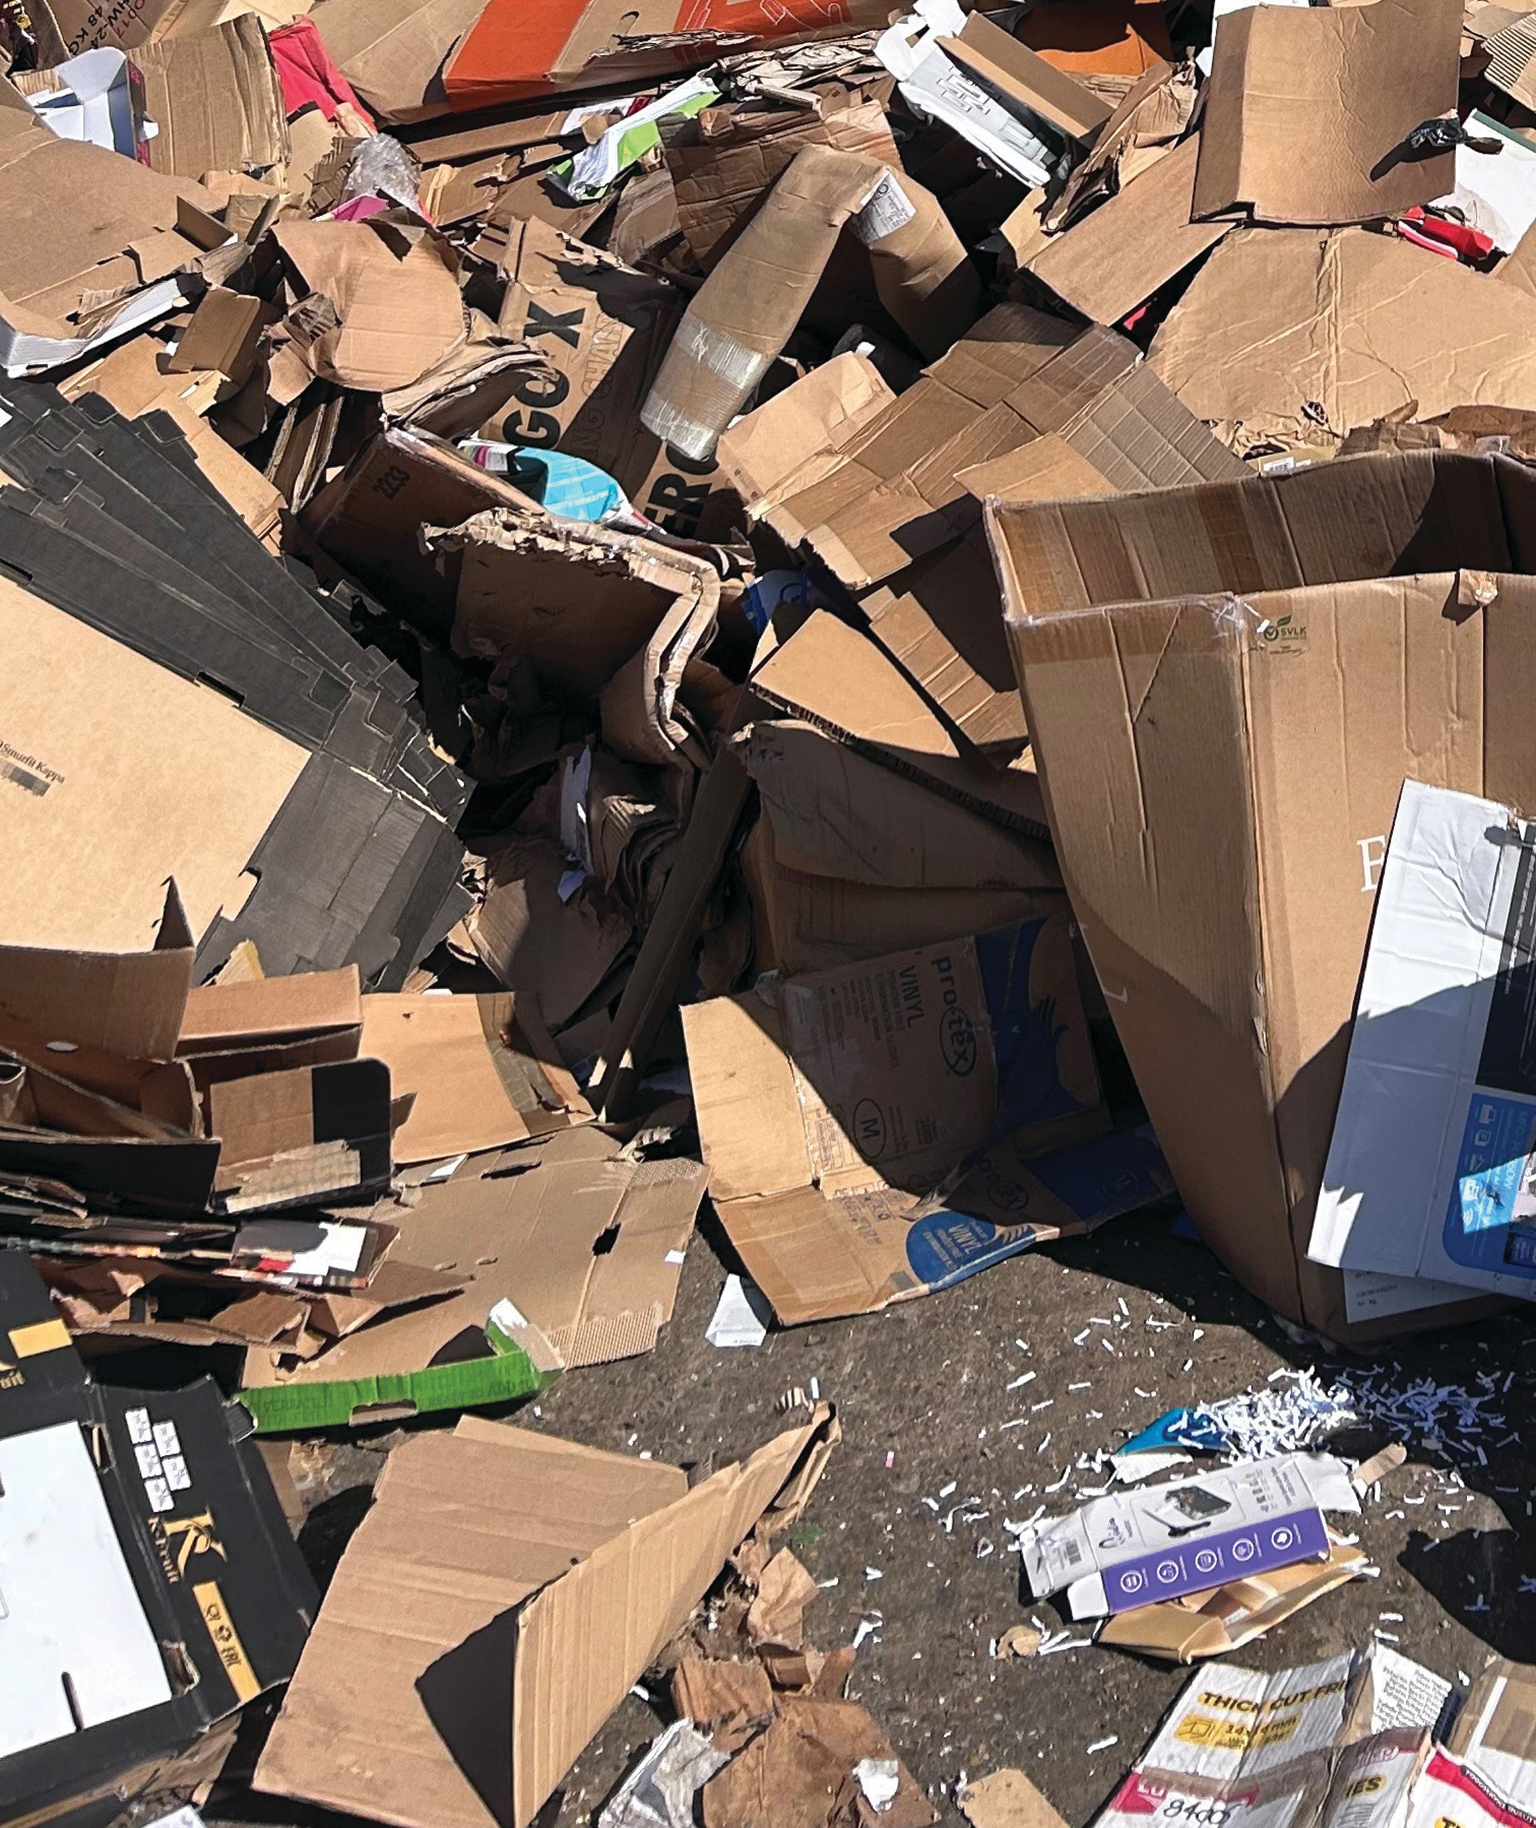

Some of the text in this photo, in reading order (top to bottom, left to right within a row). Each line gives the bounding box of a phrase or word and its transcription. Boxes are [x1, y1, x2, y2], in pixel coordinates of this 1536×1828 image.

[1280, 626, 1306, 637] SVLK
[2, 740, 66, 784] Smurfit Kappa
[899, 965, 925, 1028] VINYL
[860, 1117, 879, 1140] M
[949, 1223, 981, 1255] VINYL
[1201, 1690, 1263, 1714] THICK
[1269, 1689, 1307, 1713] CUT
